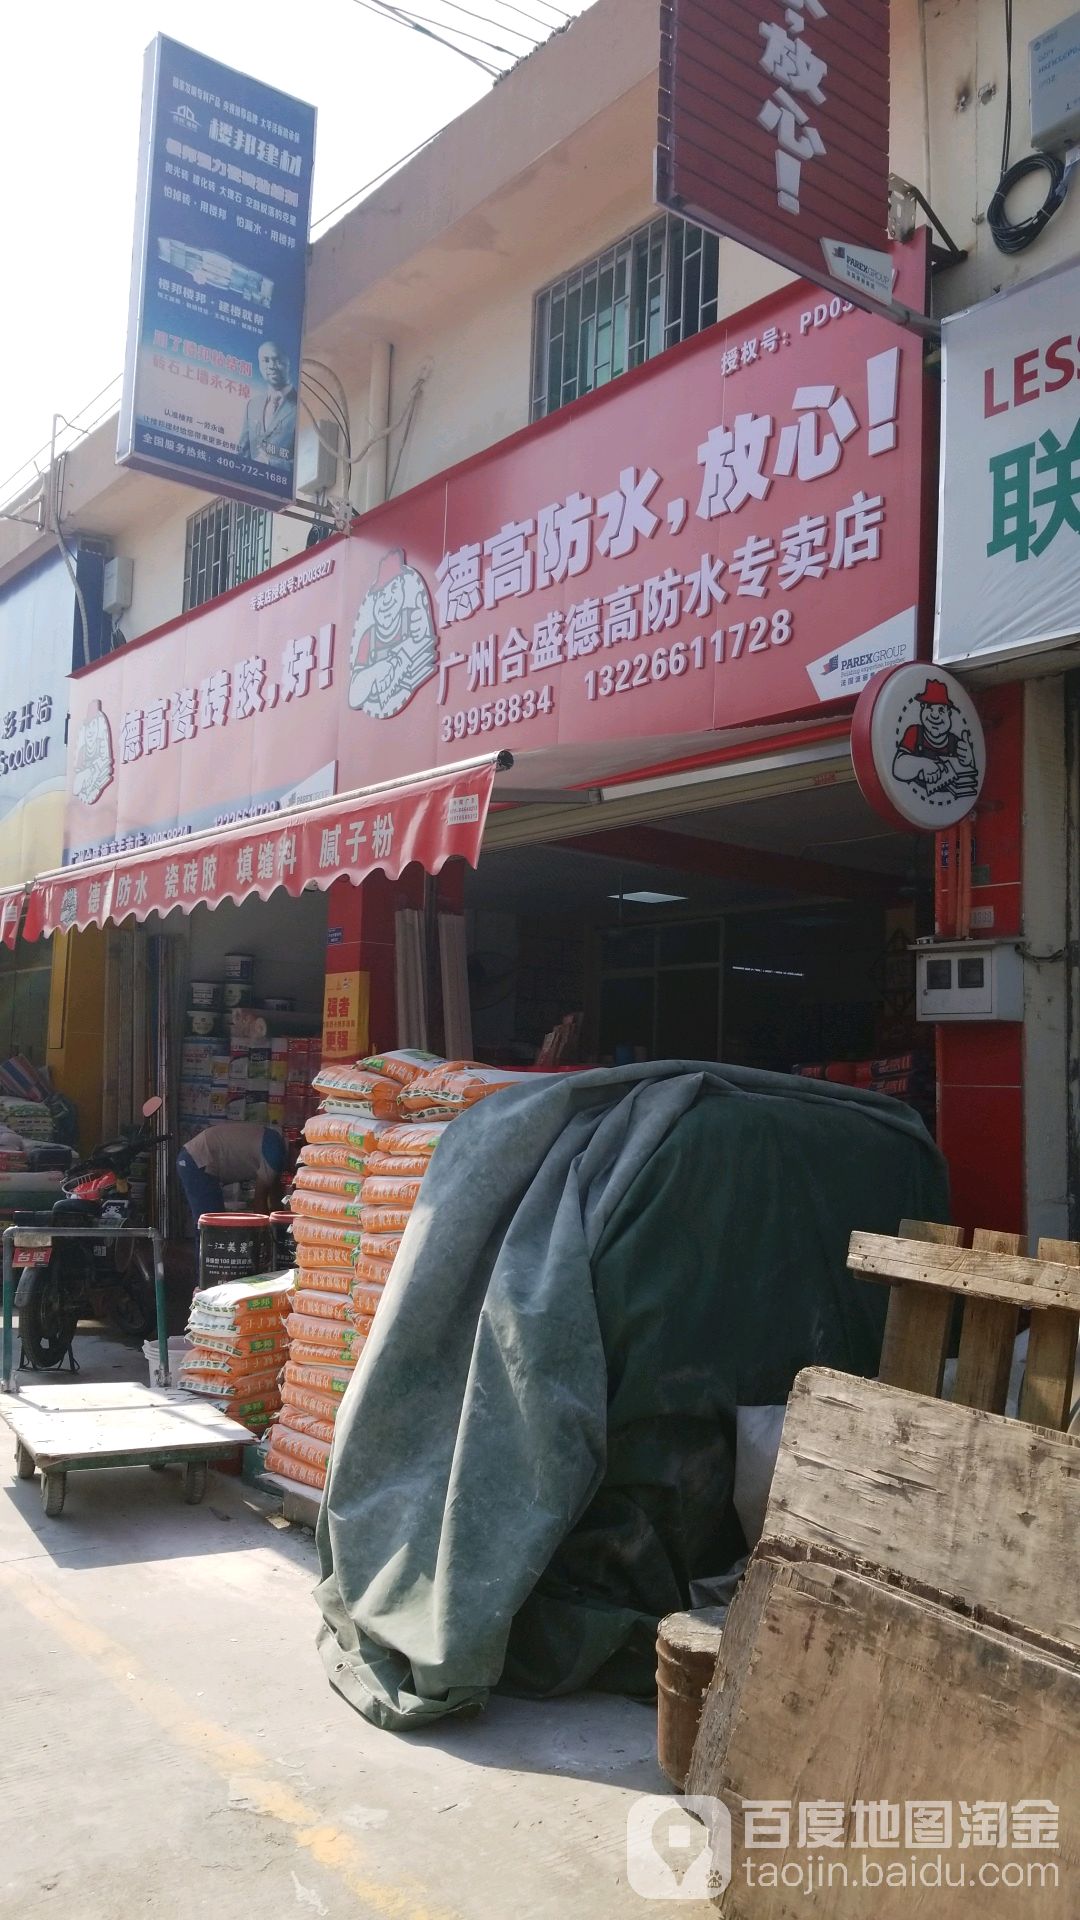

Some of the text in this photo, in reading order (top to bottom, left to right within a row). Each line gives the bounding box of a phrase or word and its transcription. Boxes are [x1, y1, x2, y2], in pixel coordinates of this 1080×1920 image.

[757, 0, 828, 215] ,放心!
[983, 334, 1080, 421] LES
[216, 455, 288, 486] 400-772-1688
[434, 346, 902, 631] 德高防水,放心!
[436, 491, 884, 705] 广州合盛德高防水专卖店
[841, 643, 907, 671] PAREXGROUP
[119, 623, 335, 764] 德高瓷砖胶,好!
[441, 608, 792, 742] 39958834 13226611728
[164, 854, 218, 900] 瓷砖胶
[236, 833, 297, 884] 填缝料
[319, 811, 395, 869] 腻子粉
